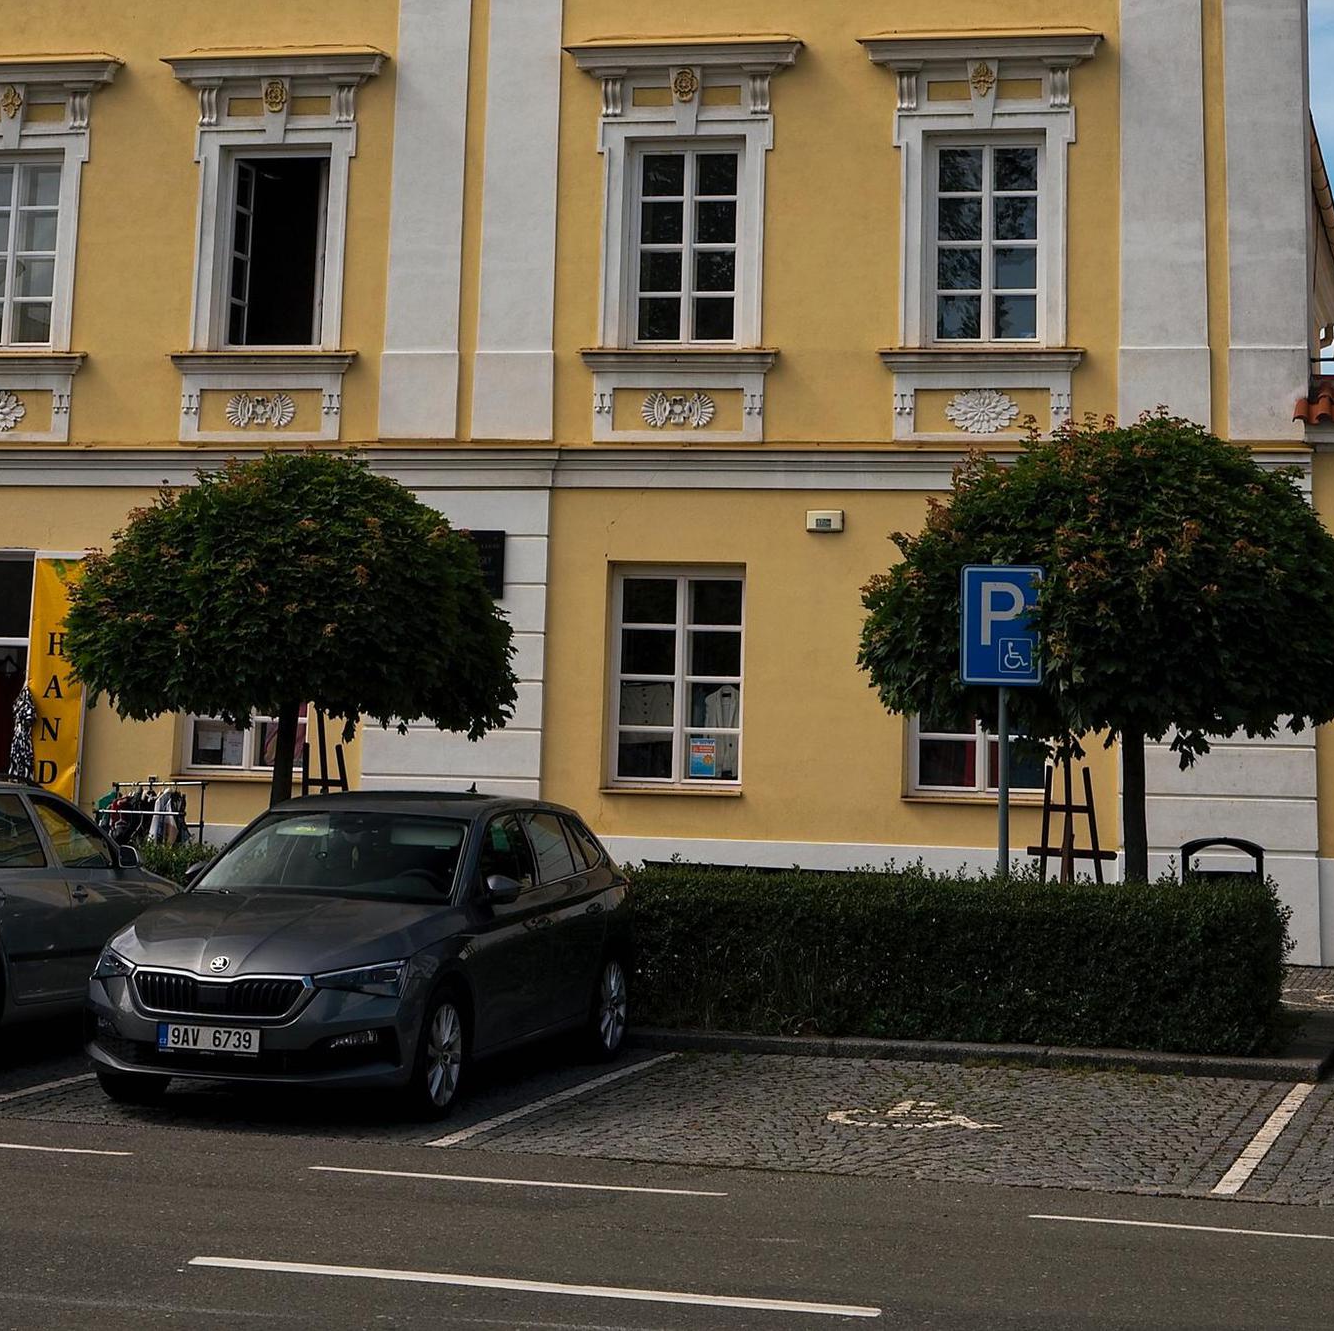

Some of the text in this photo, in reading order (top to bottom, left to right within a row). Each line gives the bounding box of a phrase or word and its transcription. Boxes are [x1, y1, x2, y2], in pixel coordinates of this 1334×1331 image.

[981, 581, 1025, 646] P
[38, 631, 65, 784] HAND
[171, 1027, 200, 1046] 9AV
[212, 1029, 252, 1049] 6739
